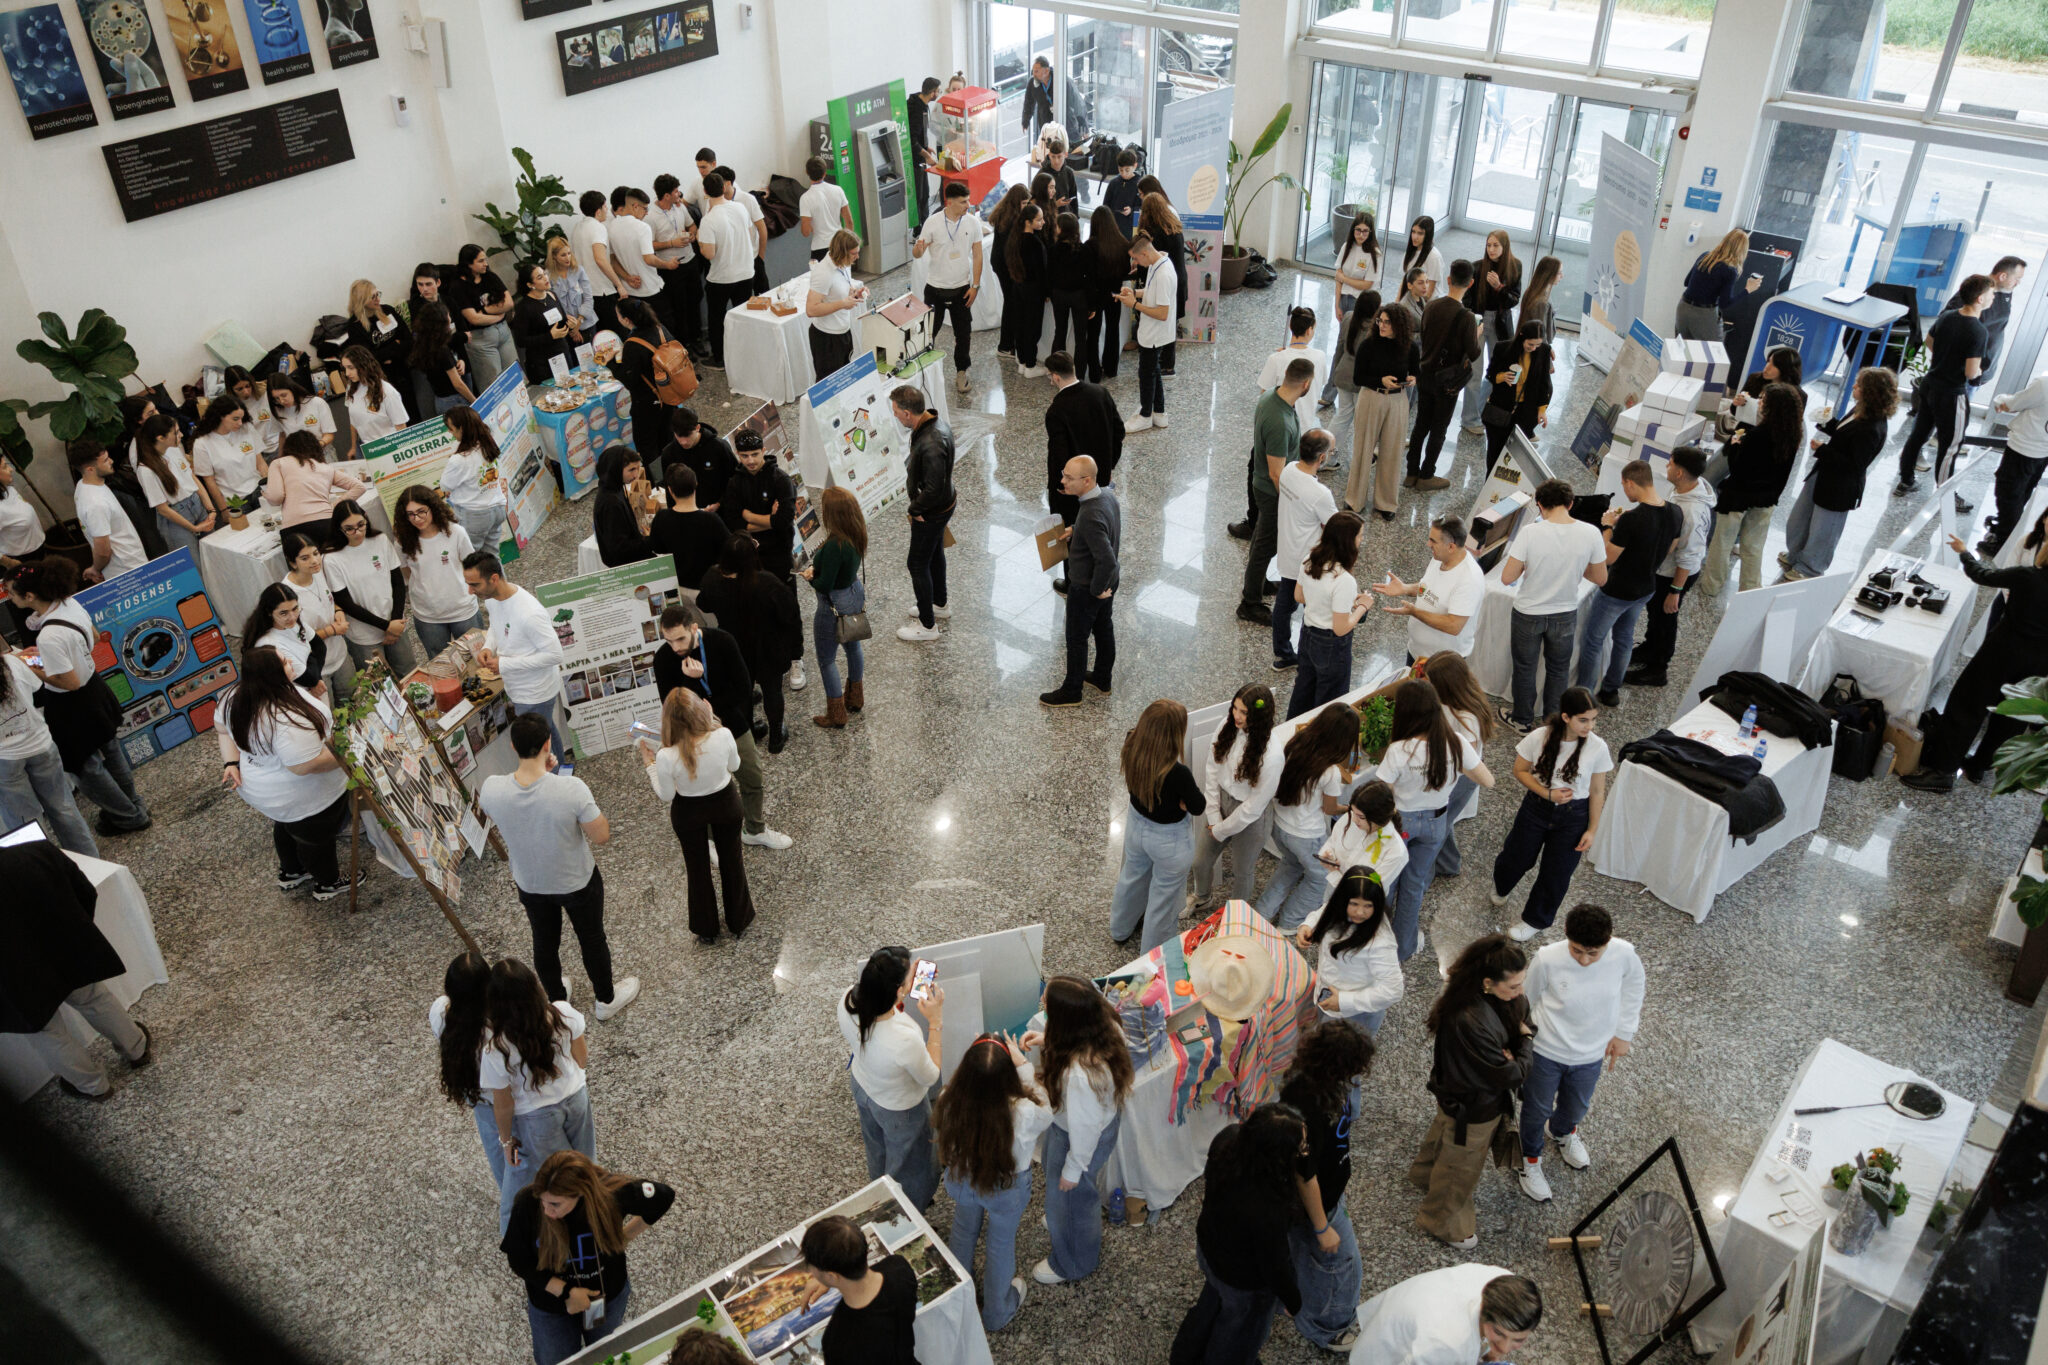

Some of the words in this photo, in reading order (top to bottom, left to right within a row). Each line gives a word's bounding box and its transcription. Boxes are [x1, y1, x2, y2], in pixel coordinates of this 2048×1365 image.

[338, 48, 369, 62] psychology
[265, 66, 285, 78] health
[286, 62, 310, 73] sciences
[212, 80, 225, 89] law
[116, 94, 170, 112] bioengineering
[856, 100, 872, 115] JCC
[873, 97, 885, 109] ATM
[34, 112, 94, 132] nanotechnology
[896, 121, 907, 136] 24
[155, 186, 220, 210] knowledge
[1777, 334, 1794, 345] 1828
[393, 435, 449, 463] BIOTERRA
[610, 649, 624, 658] ΝΕΑ
